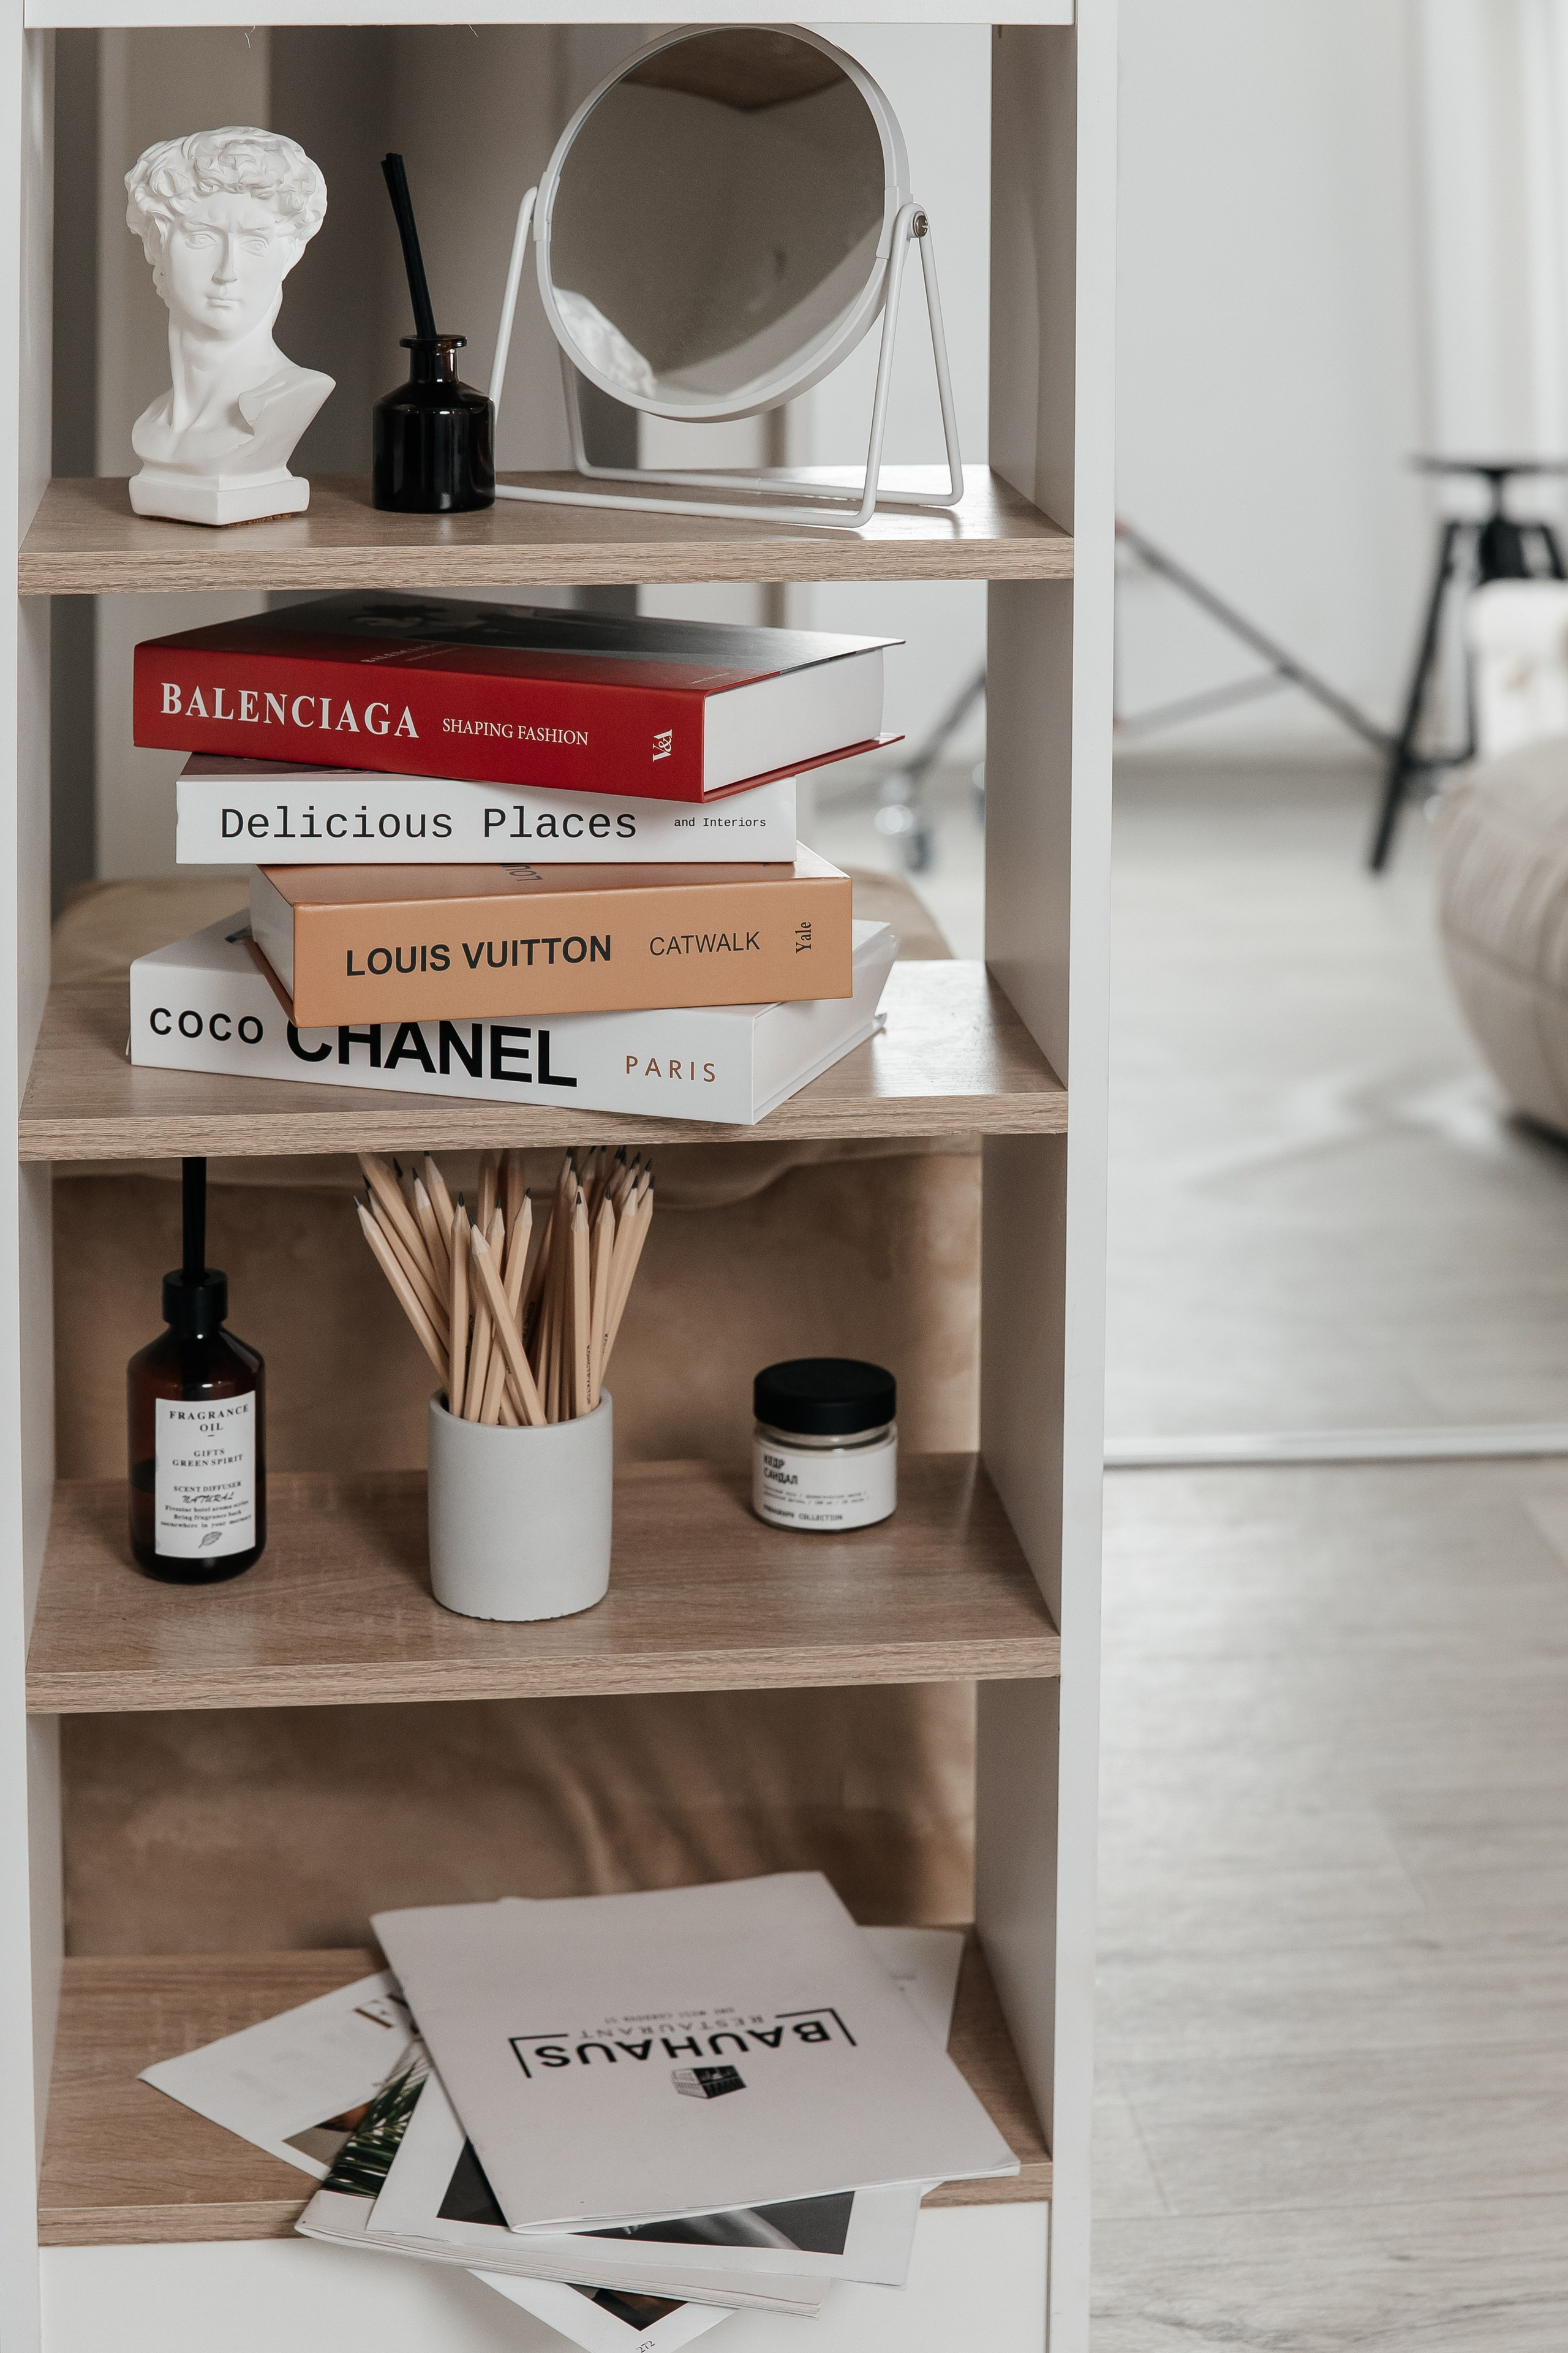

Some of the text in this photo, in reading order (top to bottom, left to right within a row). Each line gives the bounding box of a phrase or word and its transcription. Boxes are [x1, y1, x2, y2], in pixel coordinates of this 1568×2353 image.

[160, 682, 589, 746] BALENCIAGA SHAPING FASHION
[652, 729, 672, 762] V&A
[222, 806, 766, 837] Delicious Places and Interiors
[501, 864, 543, 882] LOU
[796, 921, 812, 953] Yale
[347, 931, 760, 976] LOUIS VUITTON CATWALK
[150, 1008, 263, 1044] COCO
[626, 1056, 715, 1082] PARIS
[170, 1403, 249, 1420] FRAGRANCE
[200, 1422, 224, 1432] OIL
[194, 1449, 225, 1457] GIFTS
[211, 1454, 243, 1465] SPIRIT
[203, 1481, 242, 1492] DIFFUSER
[579, 2015, 763, 2039] RESTAURANT
[535, 2021, 831, 2067] BAUHAUS
[636, 2340, 655, 2353] 272
